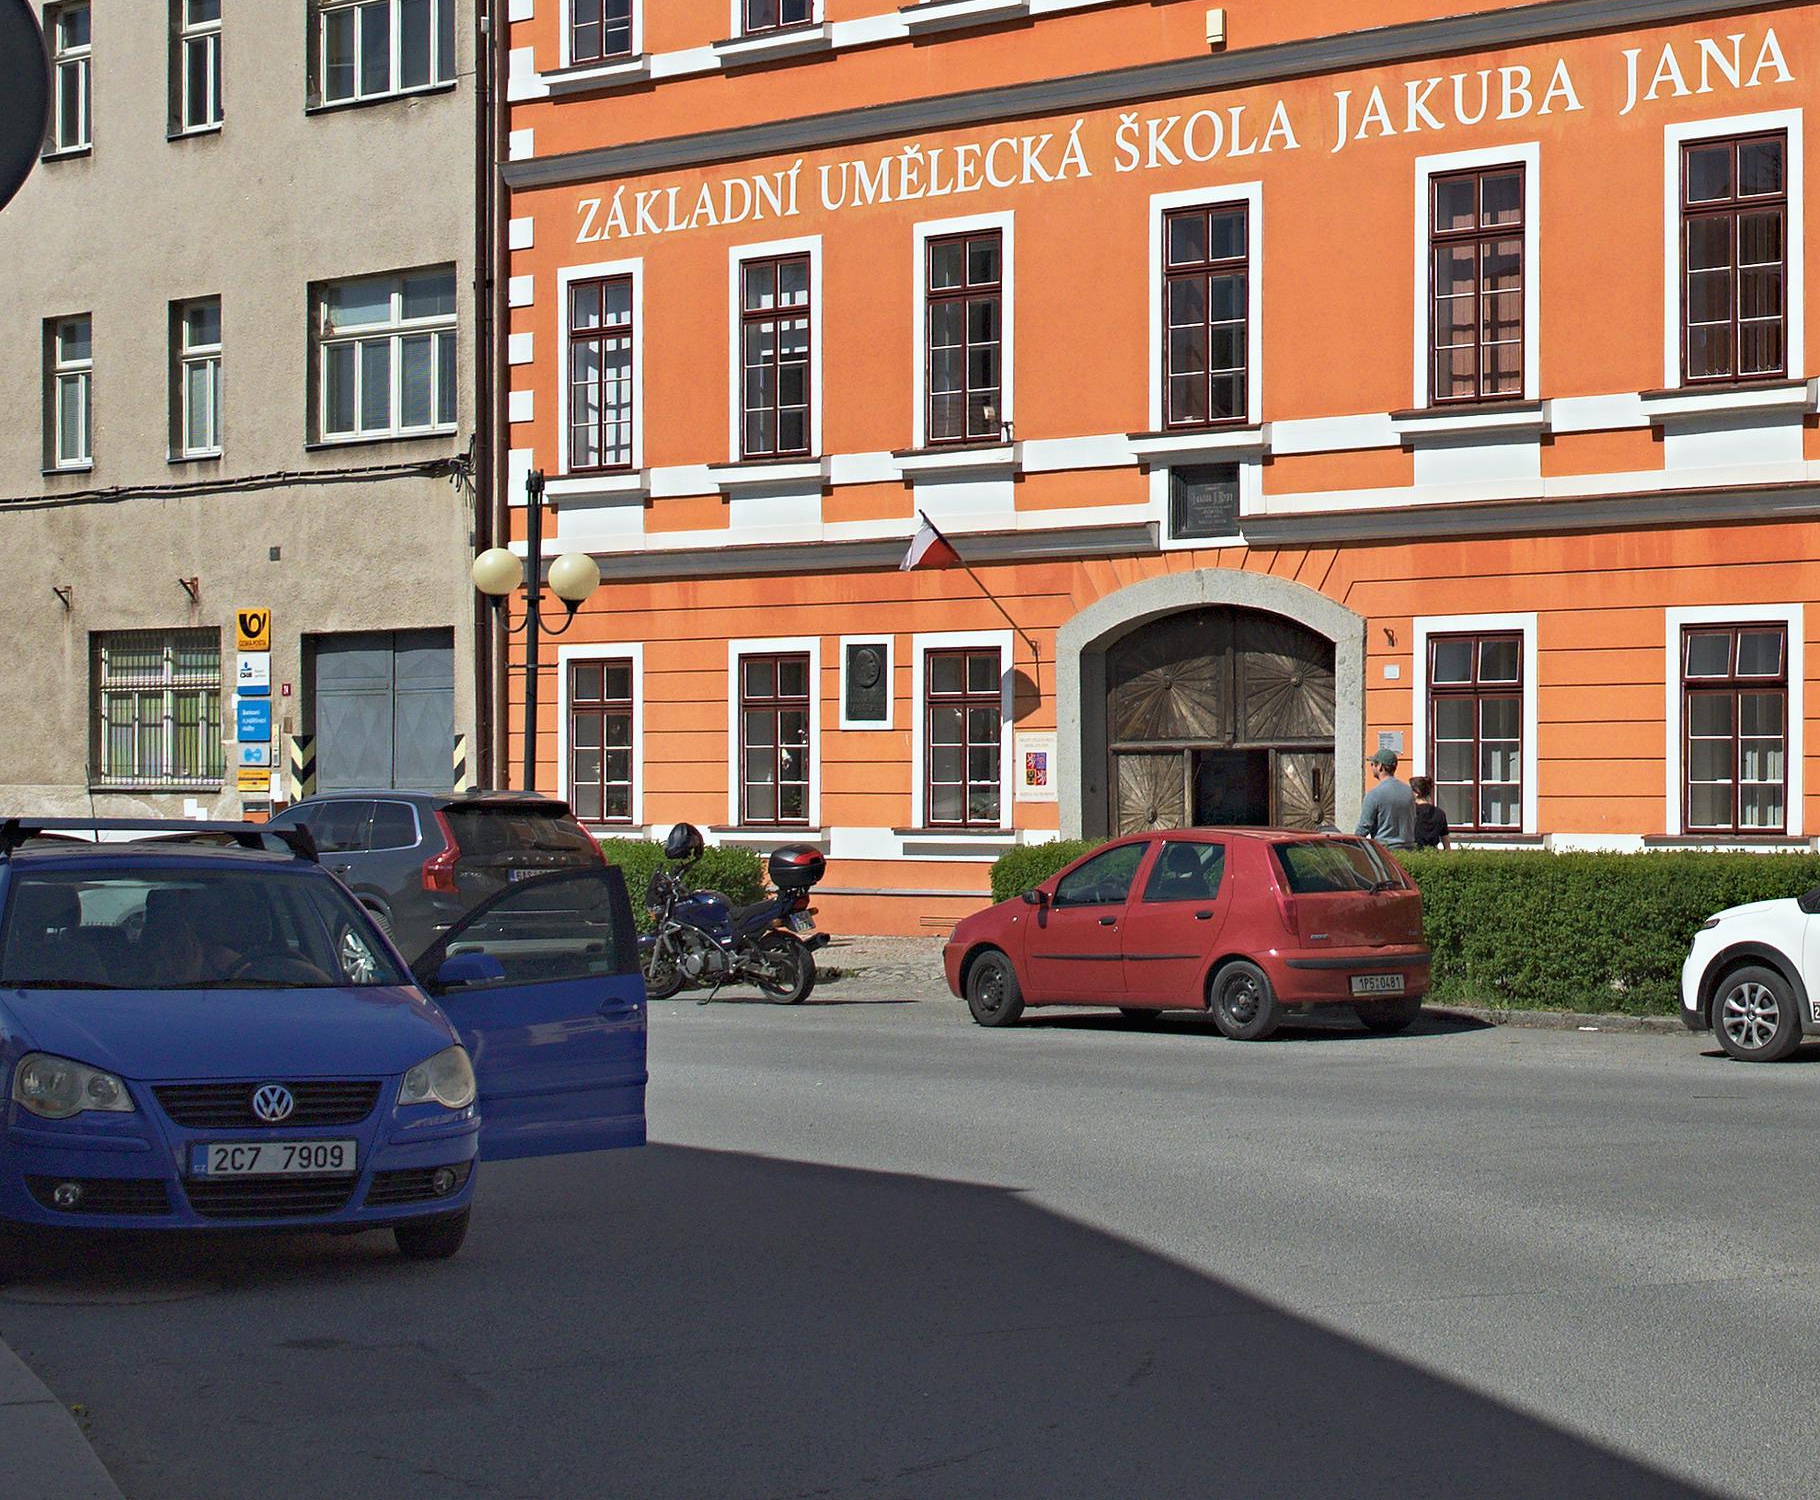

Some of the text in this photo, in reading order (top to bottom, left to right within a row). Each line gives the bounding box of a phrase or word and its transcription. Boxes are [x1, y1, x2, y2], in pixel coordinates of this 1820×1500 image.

[575, 159, 803, 244] ZÁKLADNÍ
[818, 118, 1093, 211] UMĚLECKÁ
[1114, 99, 1301, 173] ŠKOLA
[1331, 58, 1585, 153] JAKUBA
[1619, 28, 1796, 115] JANA
[1360, 975, 1401, 991] 1P5 0481
[214, 1144, 345, 1172] 2C7 7909
